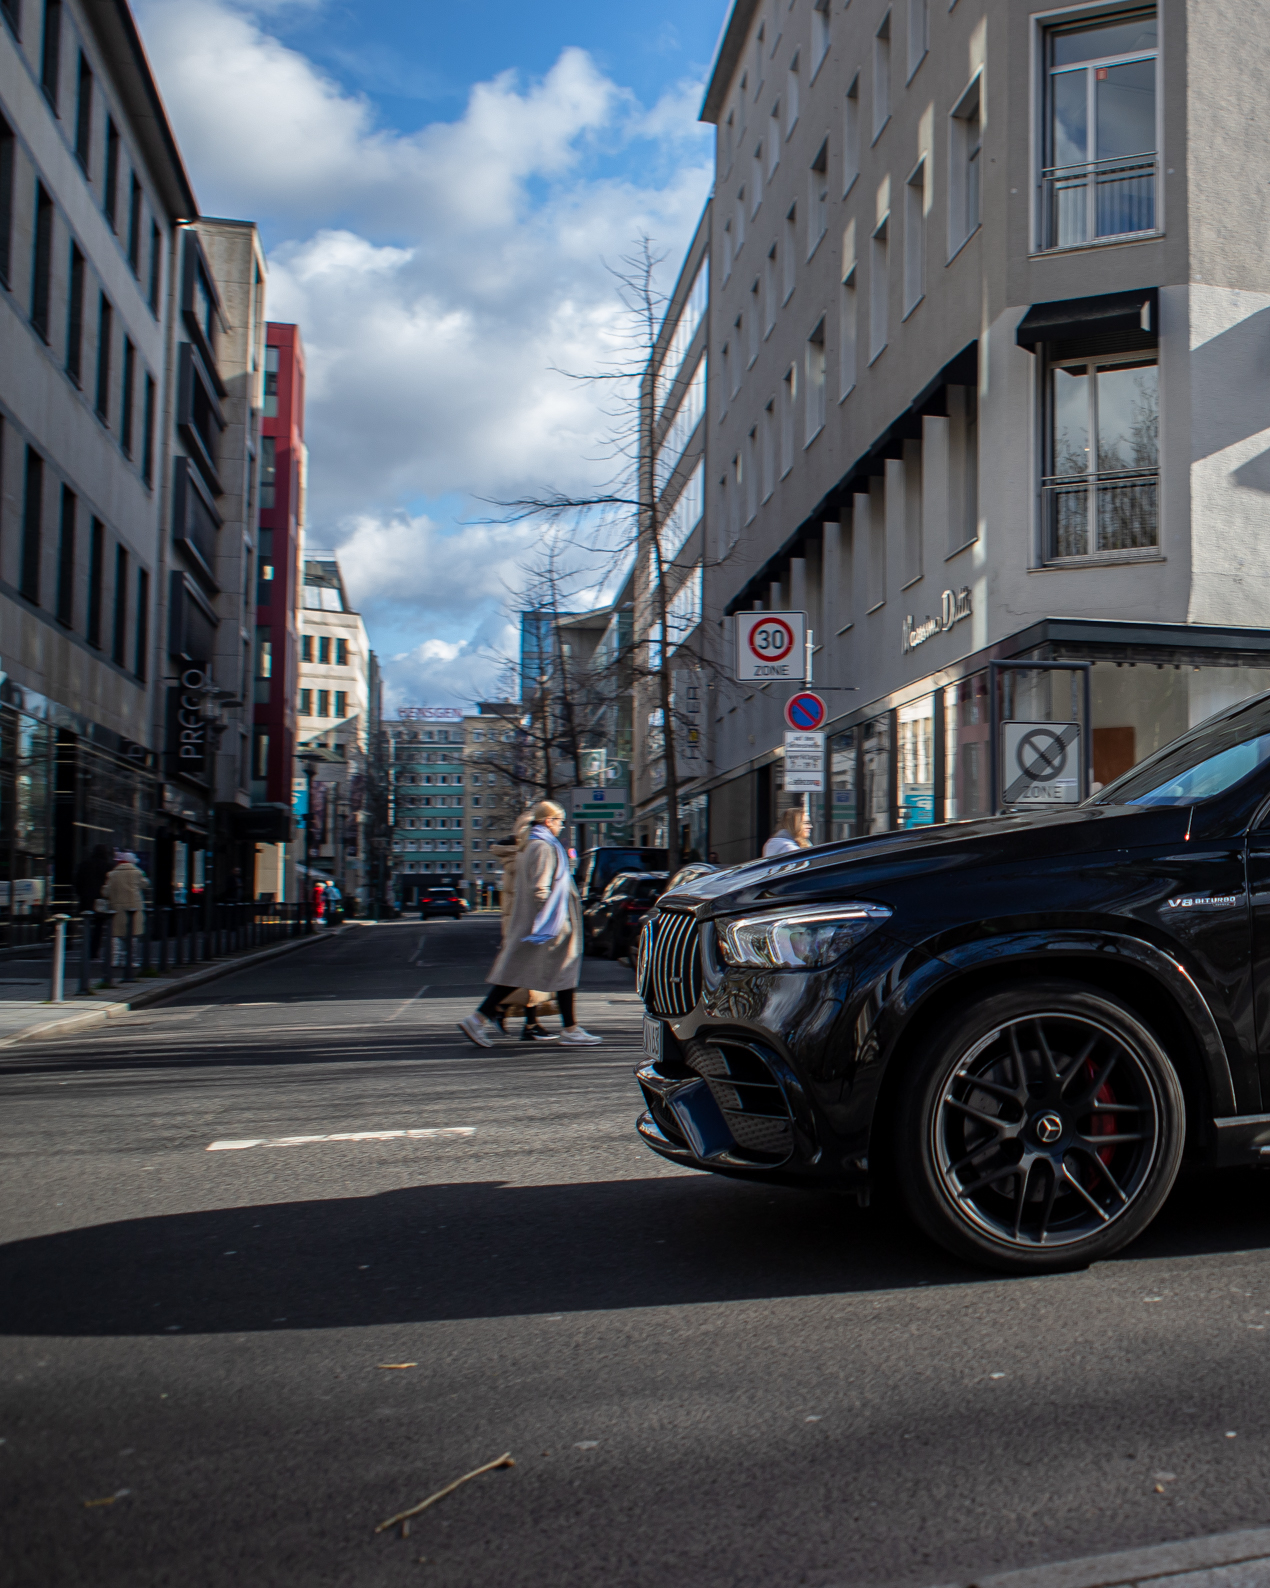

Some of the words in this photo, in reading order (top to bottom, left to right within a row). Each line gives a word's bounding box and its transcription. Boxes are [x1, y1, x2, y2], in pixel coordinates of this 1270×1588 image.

[757, 629, 785, 650] 30
[753, 664, 791, 677] ZONE
[1022, 786, 1062, 799] ZONE
[1167, 898, 1194, 908] V8
